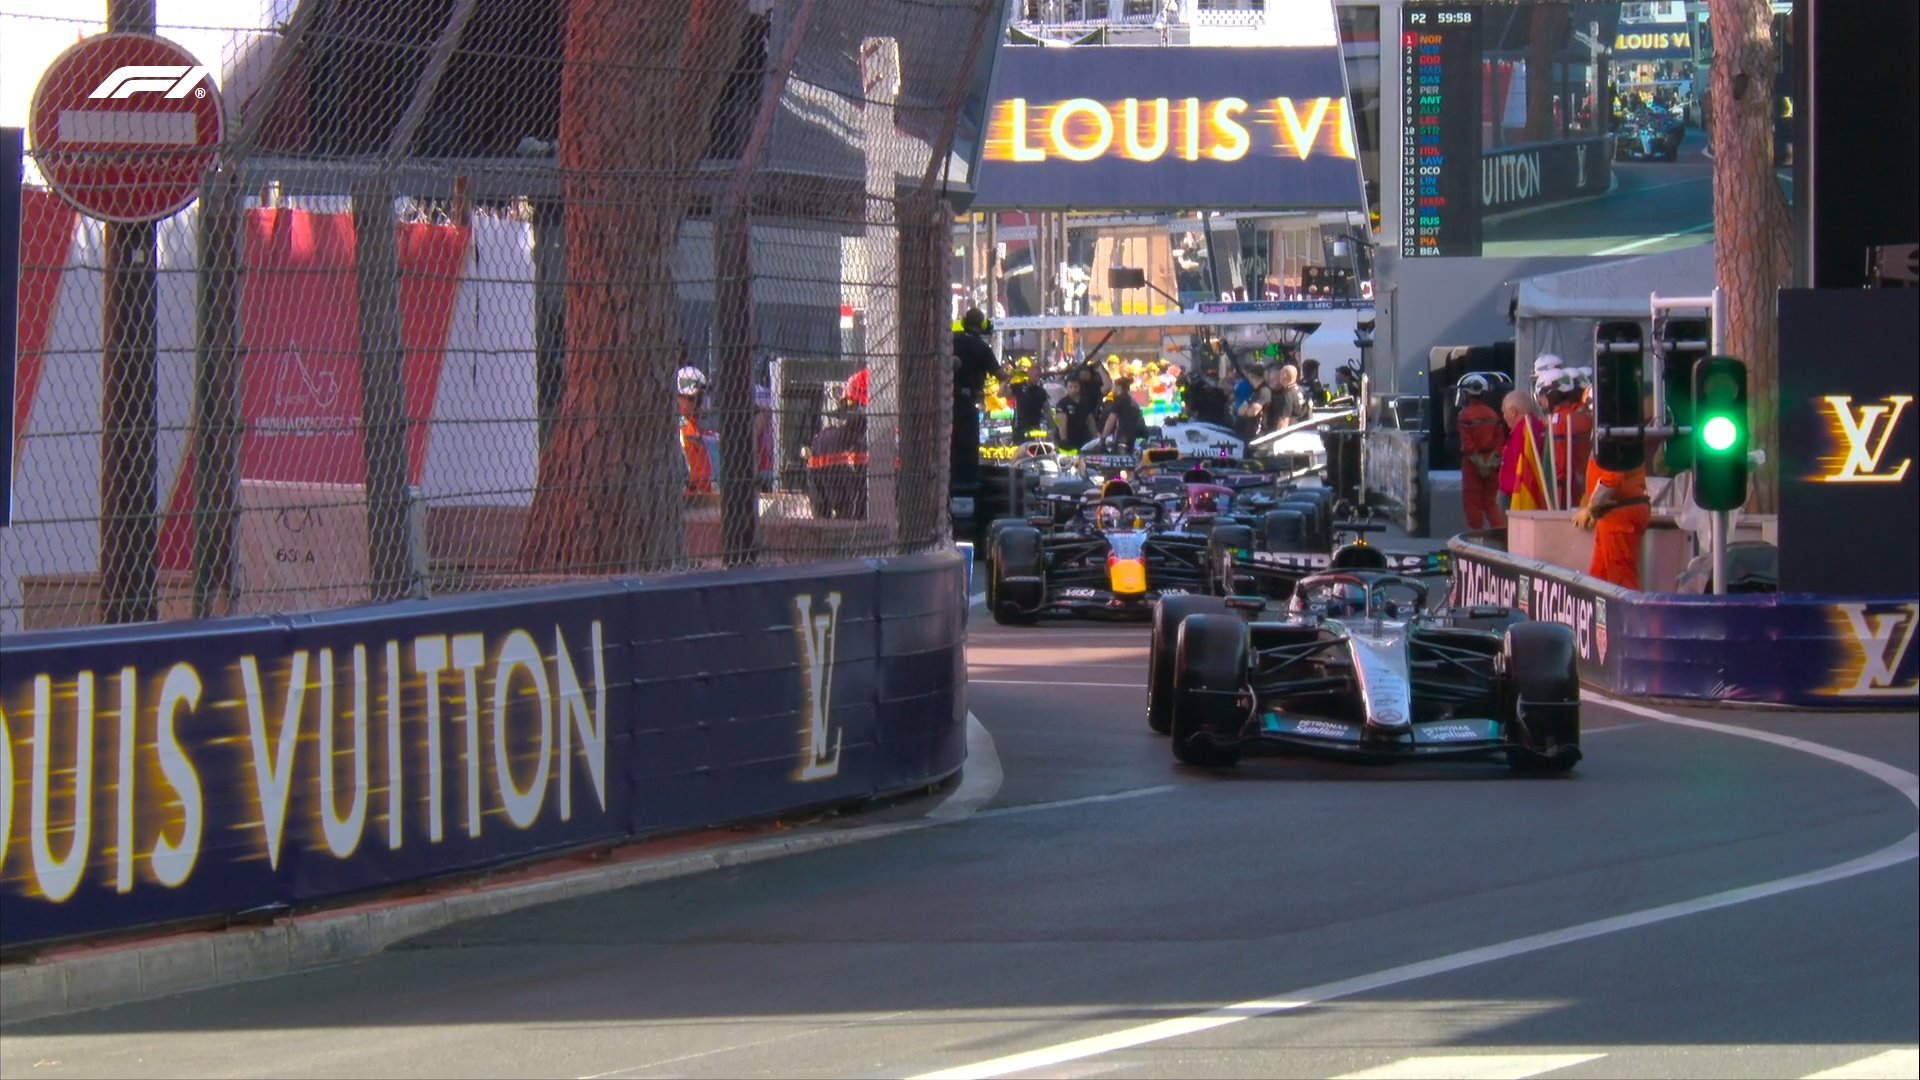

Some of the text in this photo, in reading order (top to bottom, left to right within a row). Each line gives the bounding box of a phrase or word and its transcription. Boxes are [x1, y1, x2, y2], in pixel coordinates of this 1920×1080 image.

[1411, 12, 1472, 24] P2 59:58
[1406, 36, 1442, 44] 1 NOR
[1621, 33, 1669, 50] LOUIS
[1406, 46, 1412, 54] 2
[1406, 56, 1412, 64] 3
[1406, 66, 1412, 74] 4
[1406, 76, 1412, 84] 5
[1406, 86, 1439, 94] 6 PER
[1406, 96, 1442, 105] 7 ANT
[1406, 116, 1412, 125] 9
[1012, 96, 1251, 162] LOUIS
[1404, 126, 1439, 135] 10 STR
[1404, 136, 1415, 145] 11
[1404, 146, 1415, 155] 12
[1404, 156, 1415, 165] 13
[1404, 166, 1440, 175] 14 OCO
[1404, 176, 1415, 185] 15
[1404, 187, 1438, 195] 16 COL
[1404, 197, 1415, 205] 17
[1404, 217, 1440, 225] 19 RUS
[1404, 227, 1440, 235] 20 BOT
[1404, 237, 1437, 246] 21 PIA
[1404, 247, 1440, 256] 22 BEA
[1252, 551, 1422, 568] PETRAS
[1064, 588, 1096, 597] VISA
[1299, 720, 1350, 731] PETRONAS
[0, 620, 606, 903] UIS VUITTON
